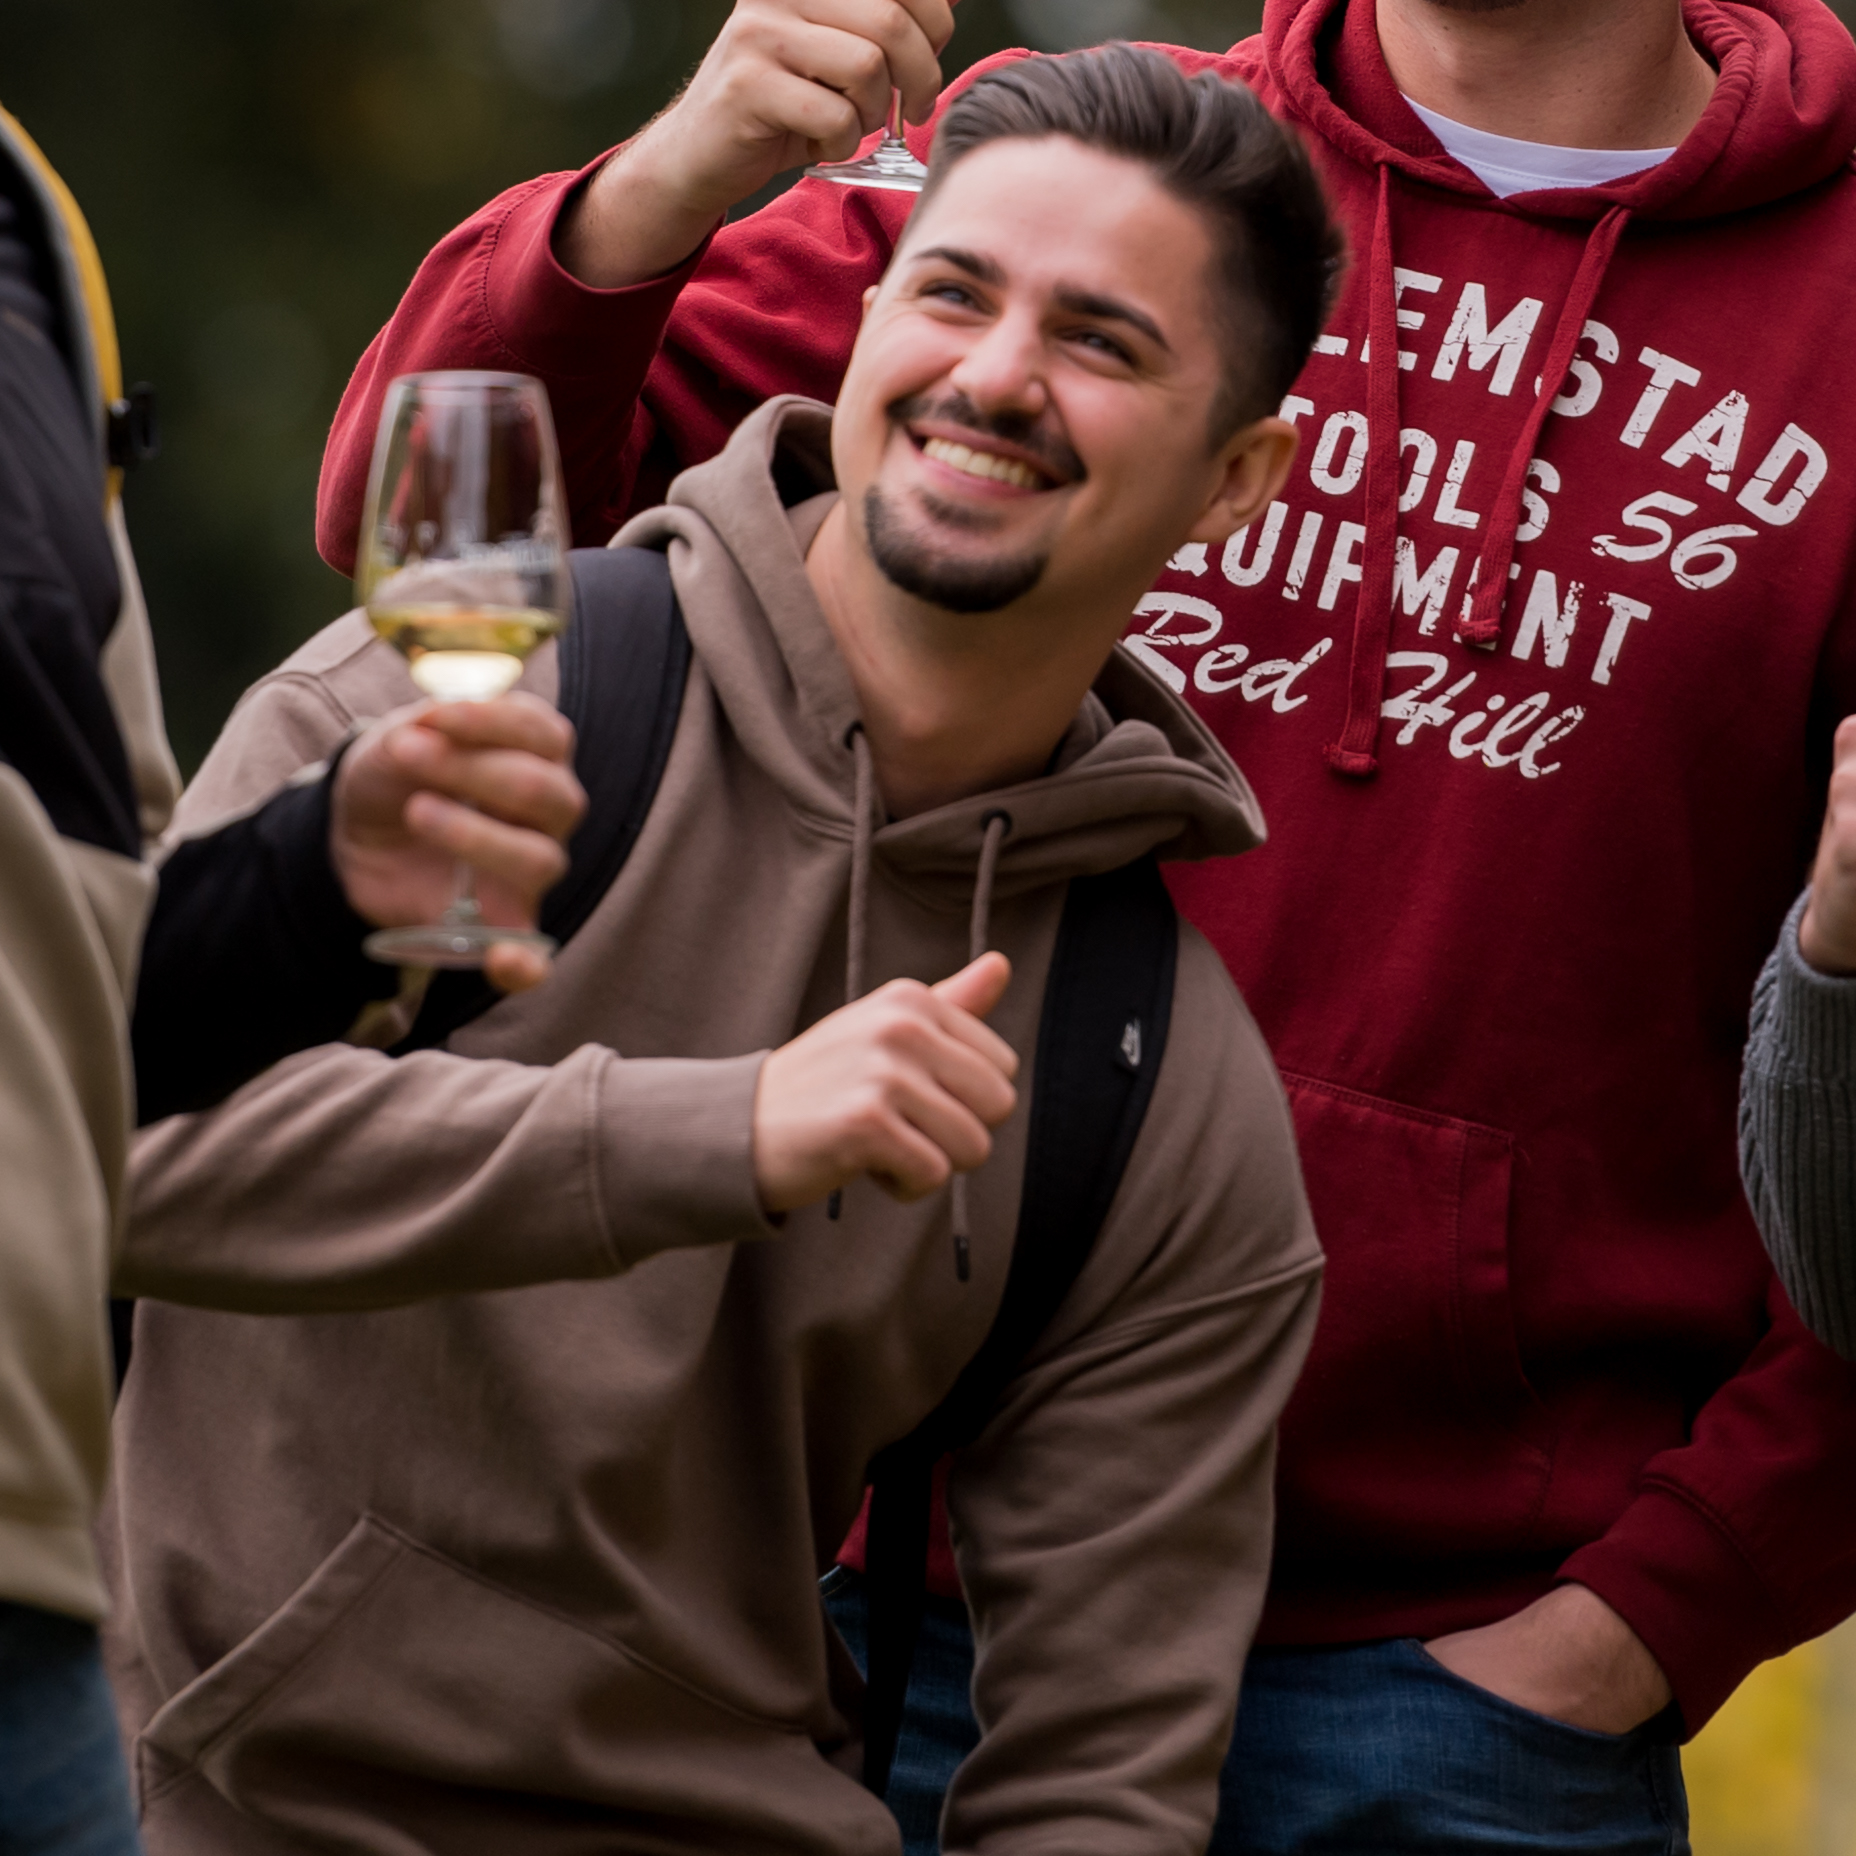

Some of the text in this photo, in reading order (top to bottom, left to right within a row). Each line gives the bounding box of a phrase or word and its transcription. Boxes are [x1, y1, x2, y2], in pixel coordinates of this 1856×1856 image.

[1313, 266, 1828, 526] EMSTAD
[1165, 500, 1652, 685] UIPMNT
[1591, 490, 1759, 590] 56
[1123, 591, 1586, 779] Red Hill
